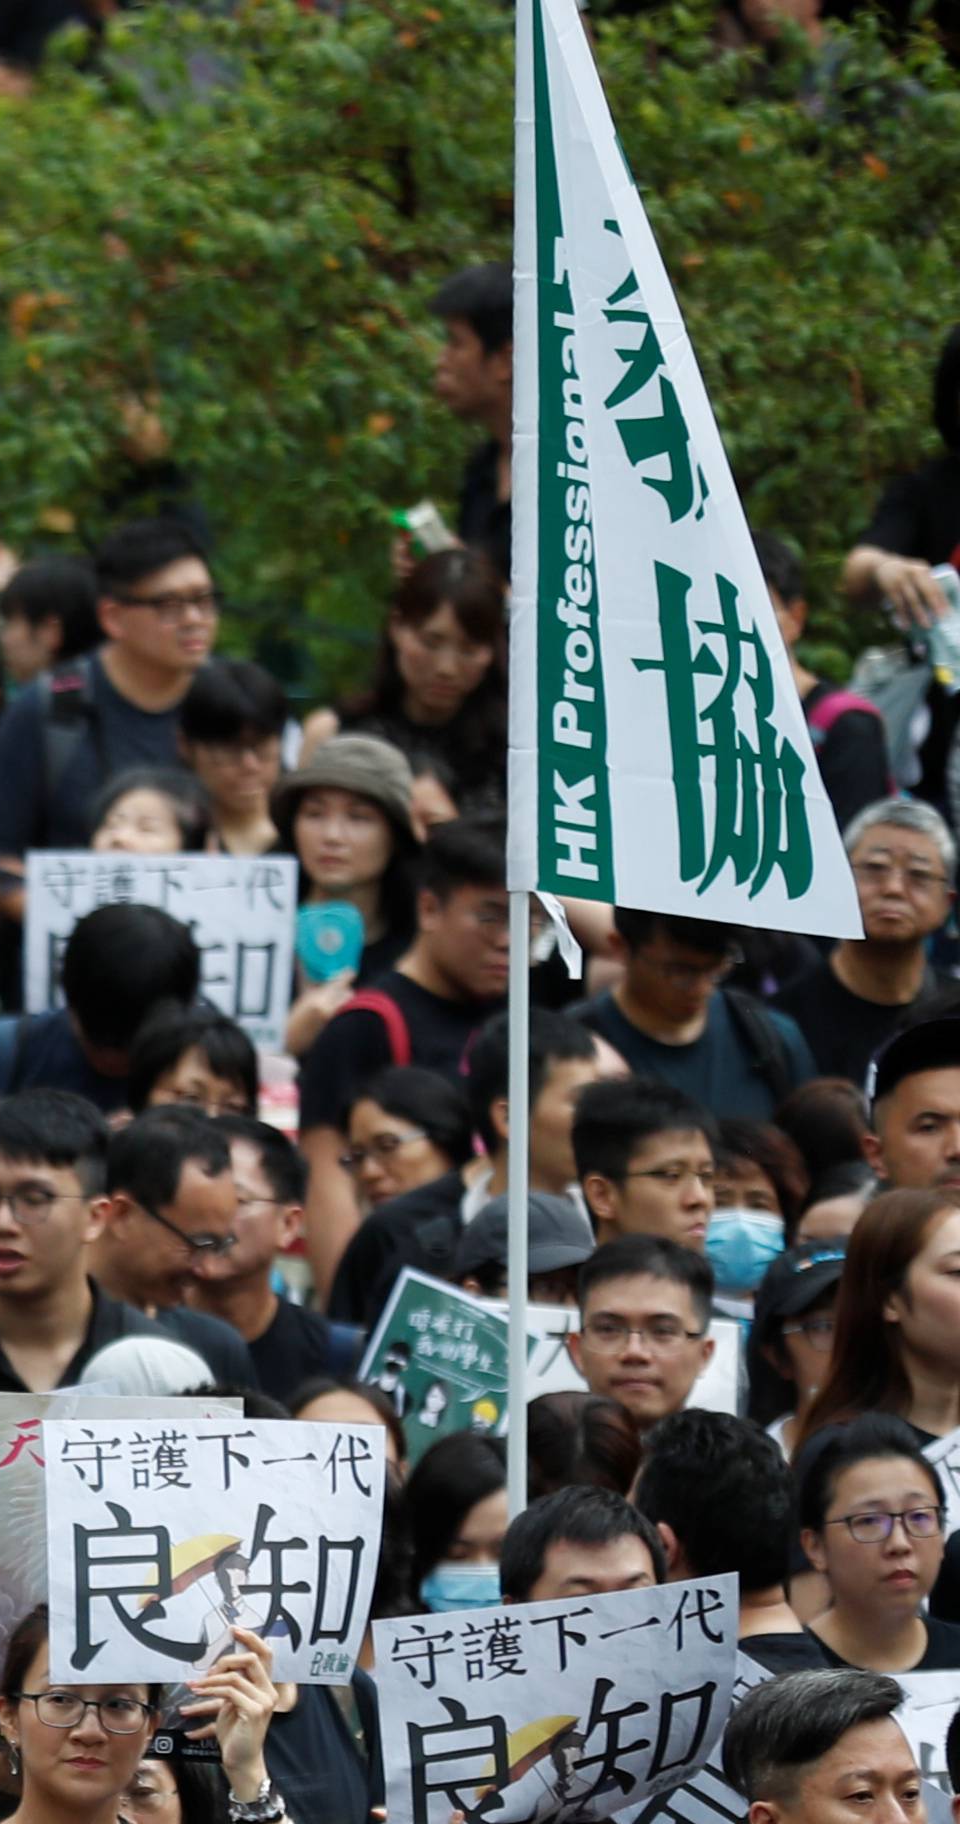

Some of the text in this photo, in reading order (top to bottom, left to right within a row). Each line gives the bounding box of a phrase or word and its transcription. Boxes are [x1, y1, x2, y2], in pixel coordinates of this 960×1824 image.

[552, 310, 598, 750] Professional
[553, 774, 600, 884] HK
[43, 860, 285, 911] 守護下一代
[60, 1428, 374, 1498] 守護下一代
[69, 1500, 366, 1672] 良知
[390, 1587, 726, 1690] 守護下一代
